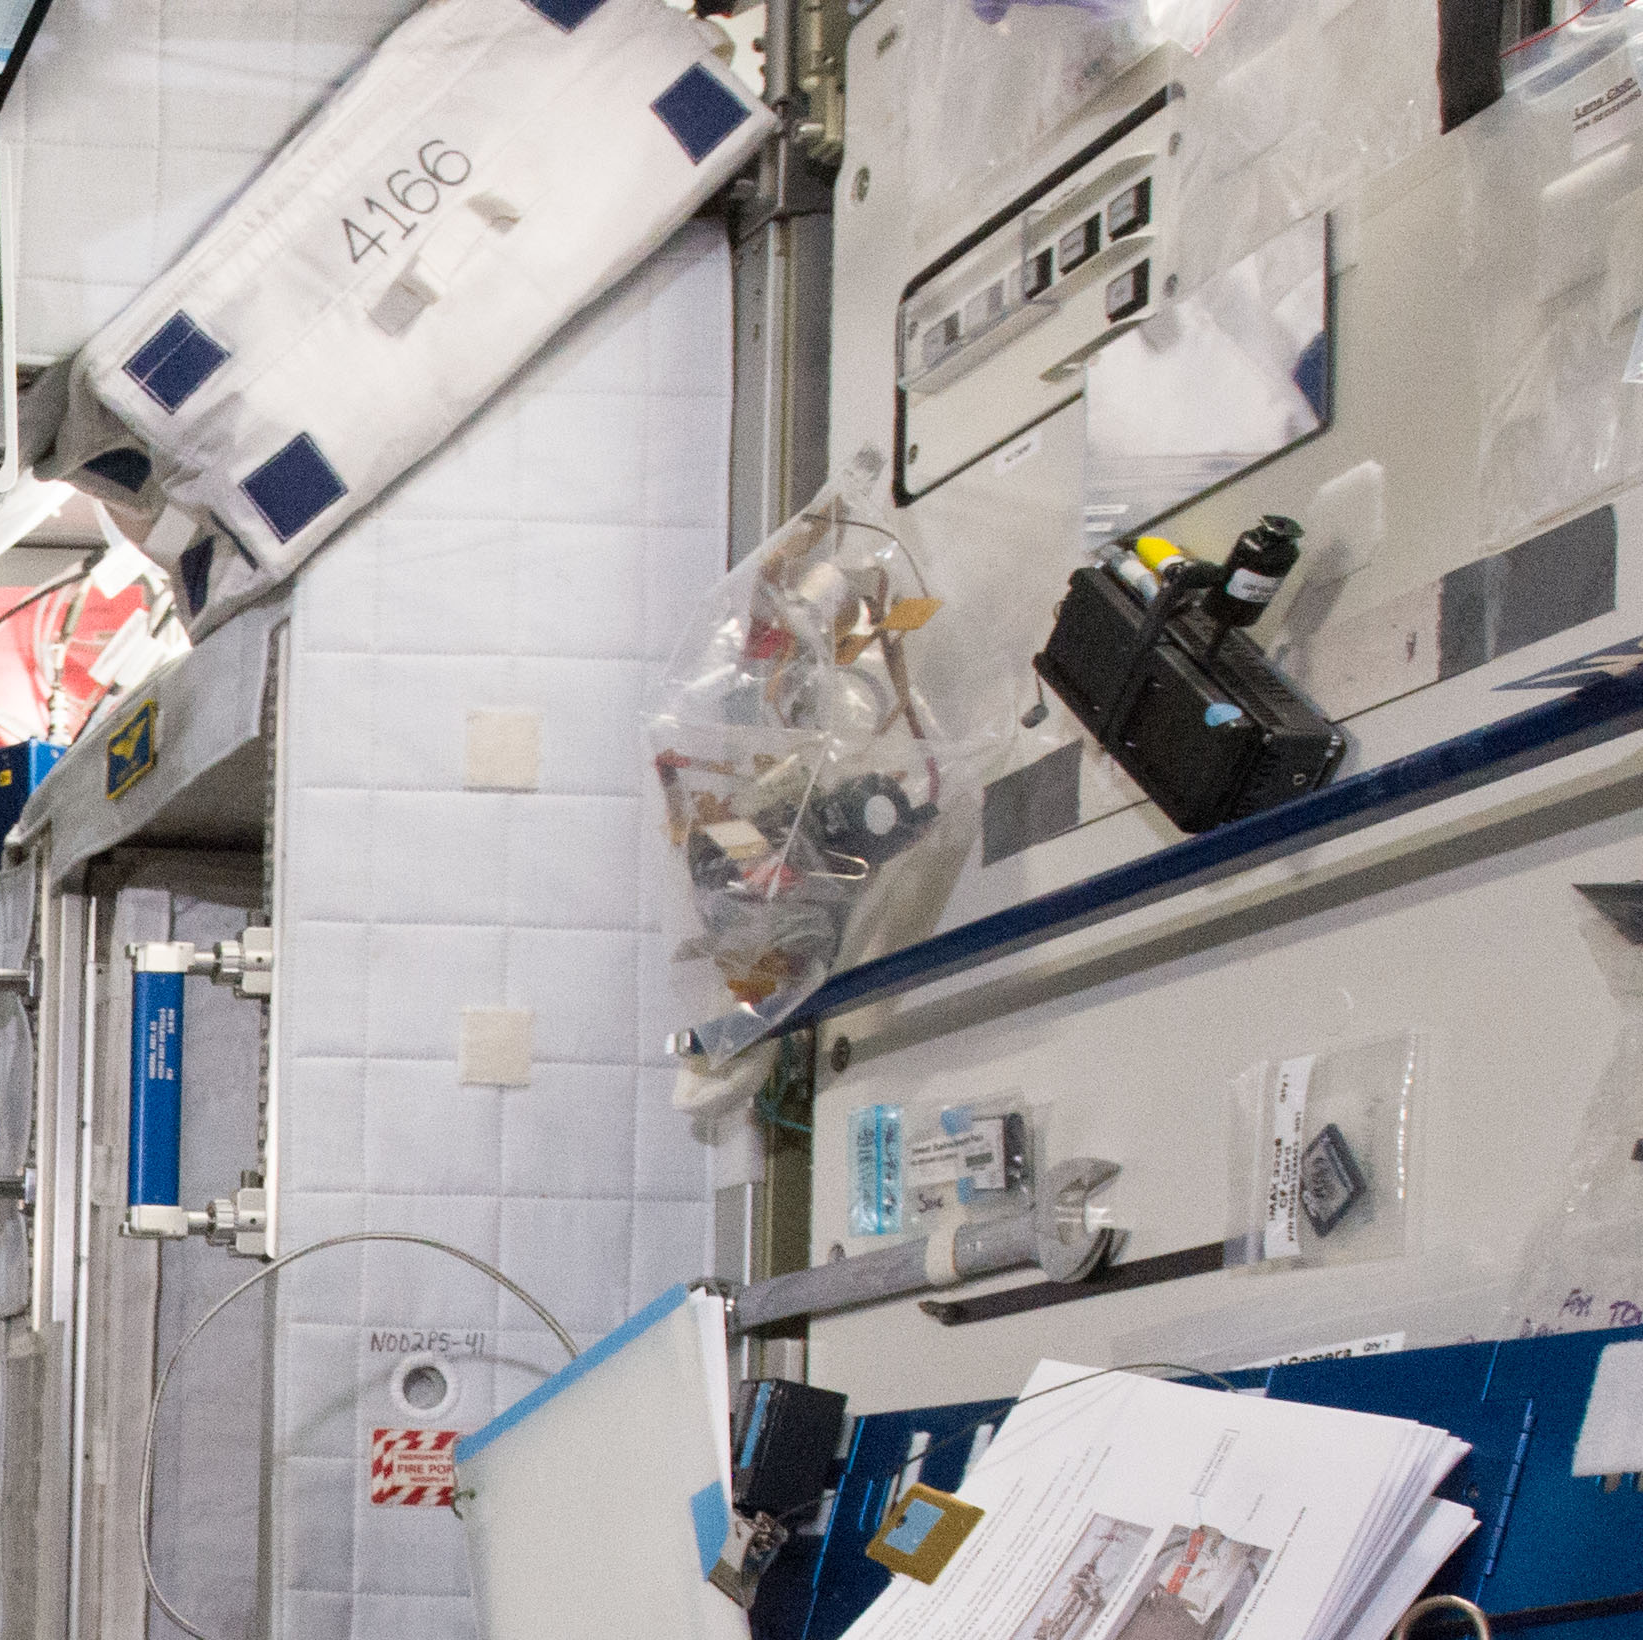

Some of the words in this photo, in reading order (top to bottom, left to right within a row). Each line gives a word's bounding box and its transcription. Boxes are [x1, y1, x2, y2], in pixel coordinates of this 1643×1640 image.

[340, 138, 474, 269] 4166
[1281, 1146, 1292, 1184] Card
[397, 1464, 425, 1475] FIRE
[428, 1464, 454, 1475] POR
